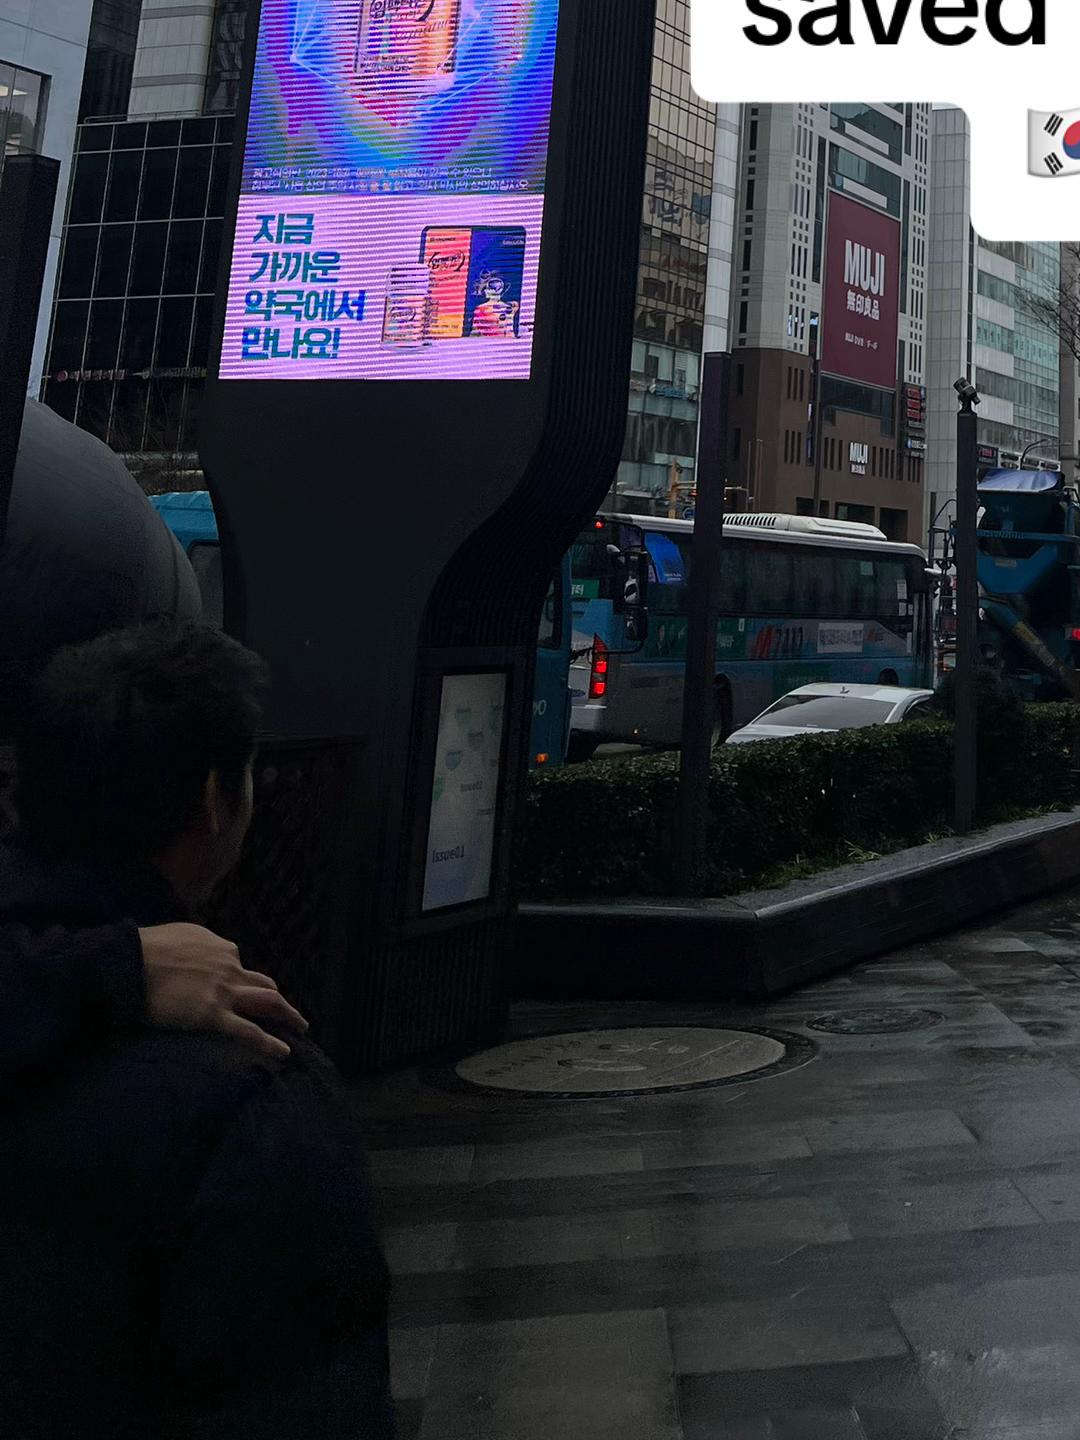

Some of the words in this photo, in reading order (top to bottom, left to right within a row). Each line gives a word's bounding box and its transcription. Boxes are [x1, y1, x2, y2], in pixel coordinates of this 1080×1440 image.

[253, 213, 315, 245] 지금
[249, 250, 341, 283] 가까운
[844, 239, 885, 296] MUJI
[244, 289, 366, 322] 약국에서
[846, 289, 880, 320] 無印良品
[241, 326, 341, 361] 만나요!
